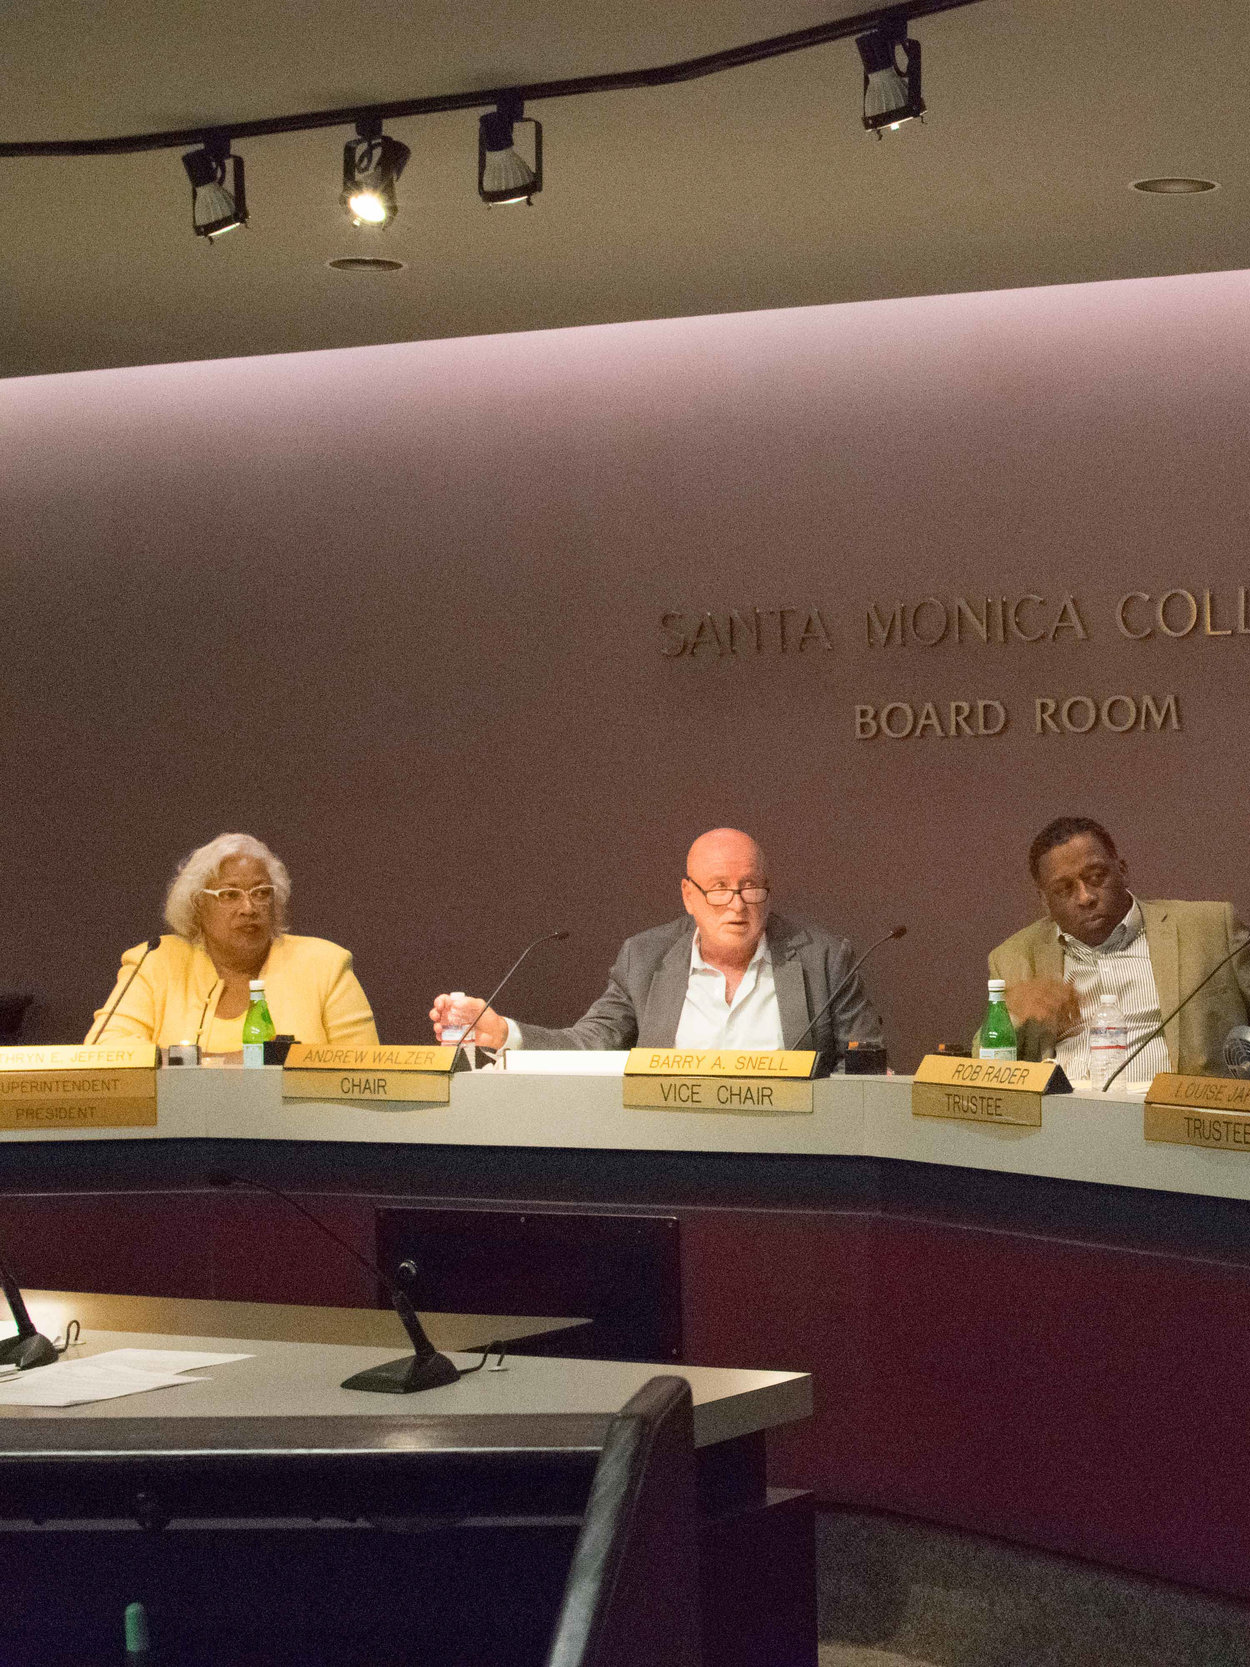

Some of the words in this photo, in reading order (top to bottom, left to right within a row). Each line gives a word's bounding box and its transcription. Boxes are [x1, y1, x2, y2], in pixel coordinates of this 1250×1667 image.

[661, 607, 834, 657] SANTA
[866, 592, 1088, 648] MONICA
[853, 700, 1009, 740] BOARD
[1035, 694, 1184, 734] ROOM
[71, 1050, 135, 1063] JEFFERY
[303, 1049, 367, 1064] ANDREW
[372, 1050, 436, 1065] WALZER
[649, 1054, 706, 1070] BARRY
[711, 1056, 726, 1070] A.
[735, 1056, 789, 1072] SNELL
[951, 1063, 983, 1081] ROB
[982, 1065, 1030, 1085] RADER
[340, 1077, 387, 1095] CHAIR
[660, 1083, 702, 1104] VICE
[717, 1085, 774, 1106] CHAIR
[1174, 1082, 1227, 1101] LOUISE
[15, 1106, 97, 1121] PRESIDENT
[945, 1093, 1003, 1117] TRUSTEE
